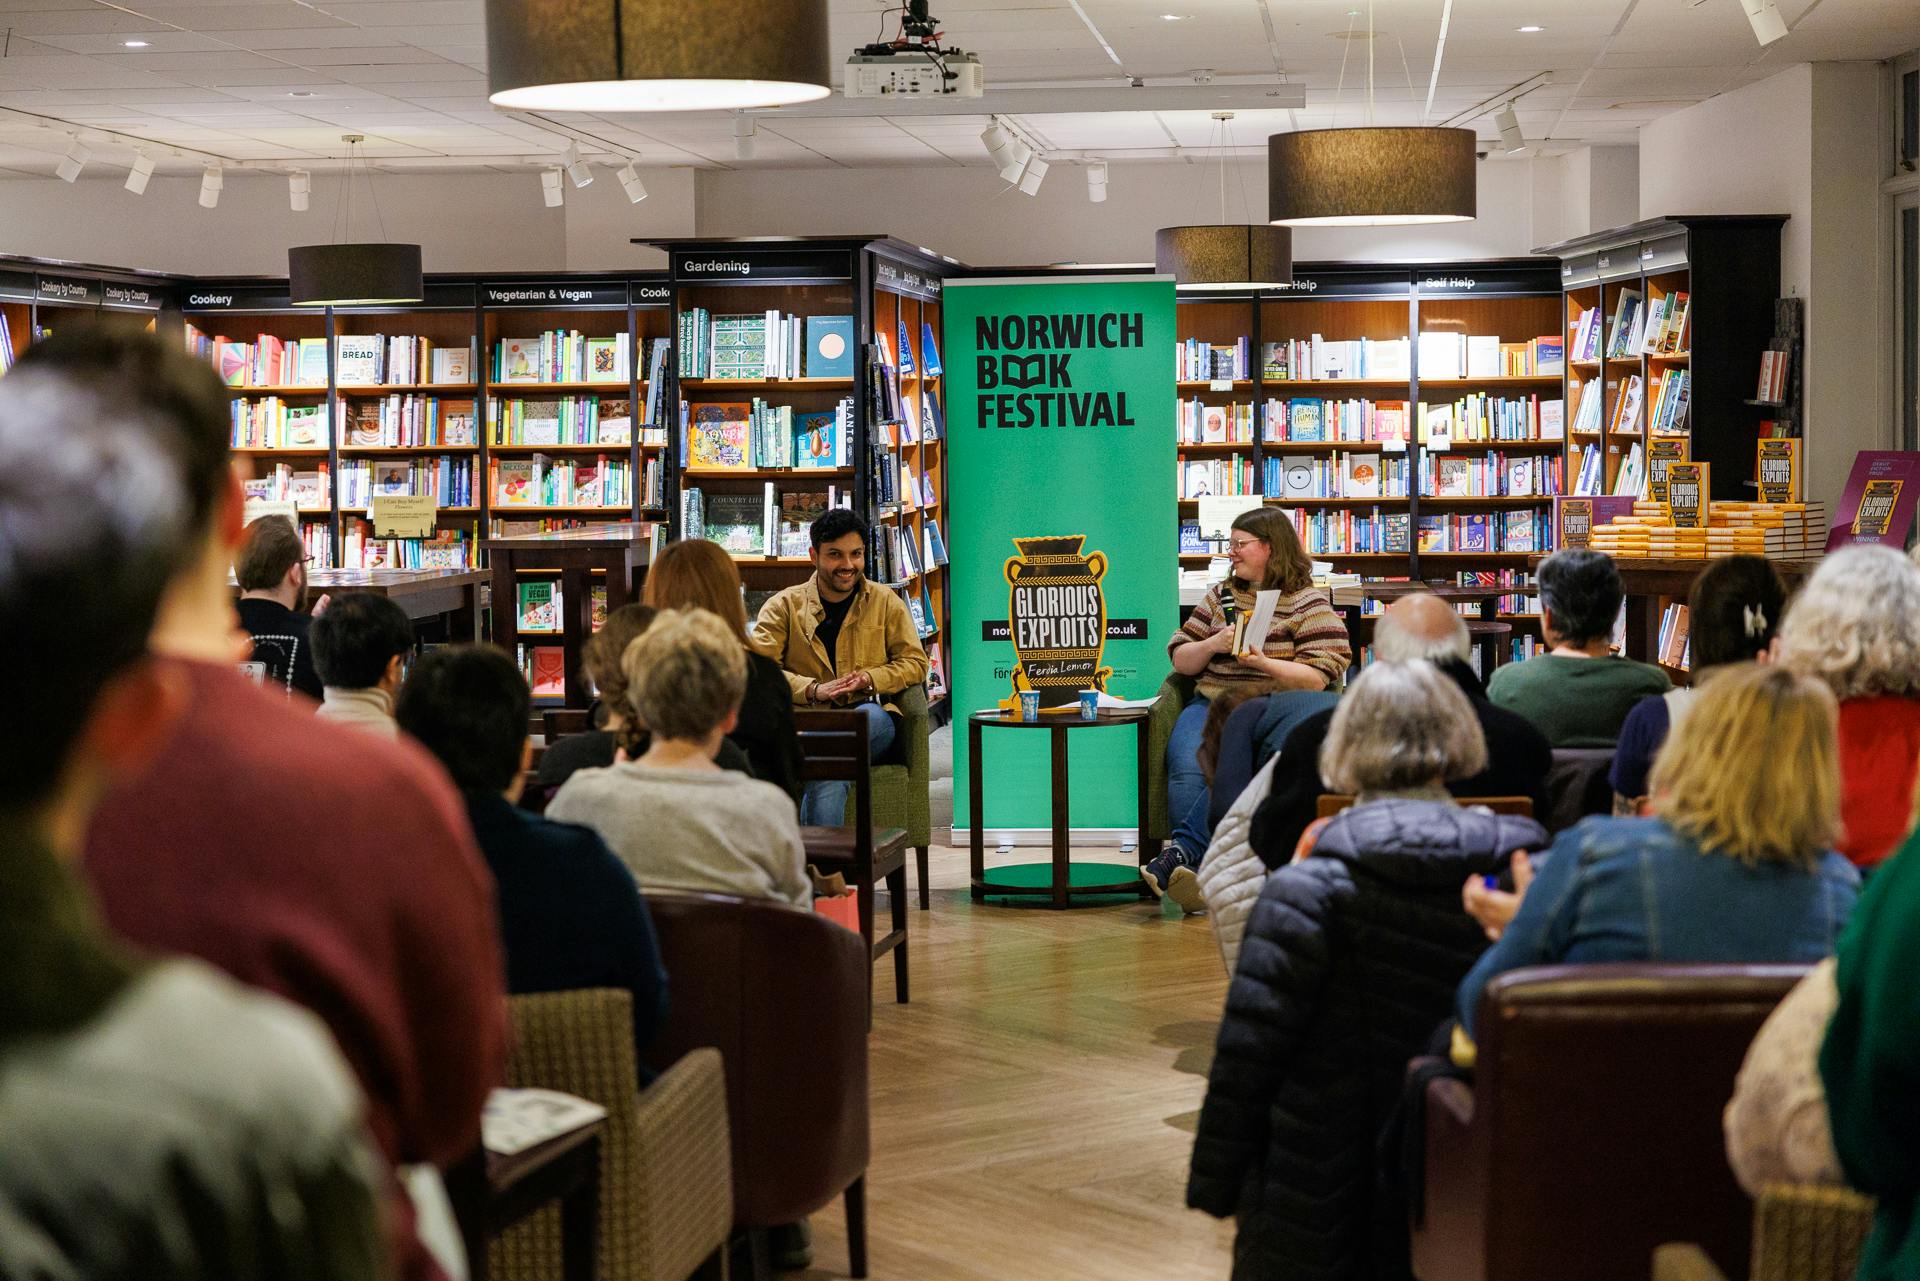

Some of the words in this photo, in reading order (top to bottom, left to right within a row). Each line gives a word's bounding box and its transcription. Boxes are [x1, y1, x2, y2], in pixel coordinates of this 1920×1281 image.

[684, 260, 750, 274] Gardening
[41, 281, 62, 295] Cookery
[61, 283, 68, 296] by
[68, 284, 87, 298] Country
[1292, 279, 1318, 292] Help
[1426, 277, 1447, 288] Self
[1449, 276, 1476, 290] Help
[106, 287, 124, 300] Cookery
[124, 289, 130, 302] by
[131, 290, 150, 303] Country
[189, 294, 232, 306] Cookery
[489, 289, 546, 301] Vegetarian
[548, 289, 557, 299] &
[559, 289, 593, 301] Vegan
[976, 312, 1143, 350] NORWICH
[342, 351, 374, 359] BREAD
[978, 391, 1135, 429] FESTIVAL
[1762, 459, 1790, 471] GLORIOUS
[1651, 470, 1668, 483] EXPL
[1762, 471, 1790, 483] EXPLOITS
[1671, 483, 1698, 496] GLORIOUS
[1671, 495, 1698, 508] EXPLOITS
[1861, 507, 1890, 517] EXPLOITS
[1564, 524, 1588, 534] EXPLOITS
[528, 589, 550, 599] VEGAN
[1015, 585, 1098, 618] GLORIOUS
[1018, 616, 1099, 649] EXPLOITS
[1105, 624, 1137, 635] .co.uk
[1027, 663, 1059, 677] Ferdia
